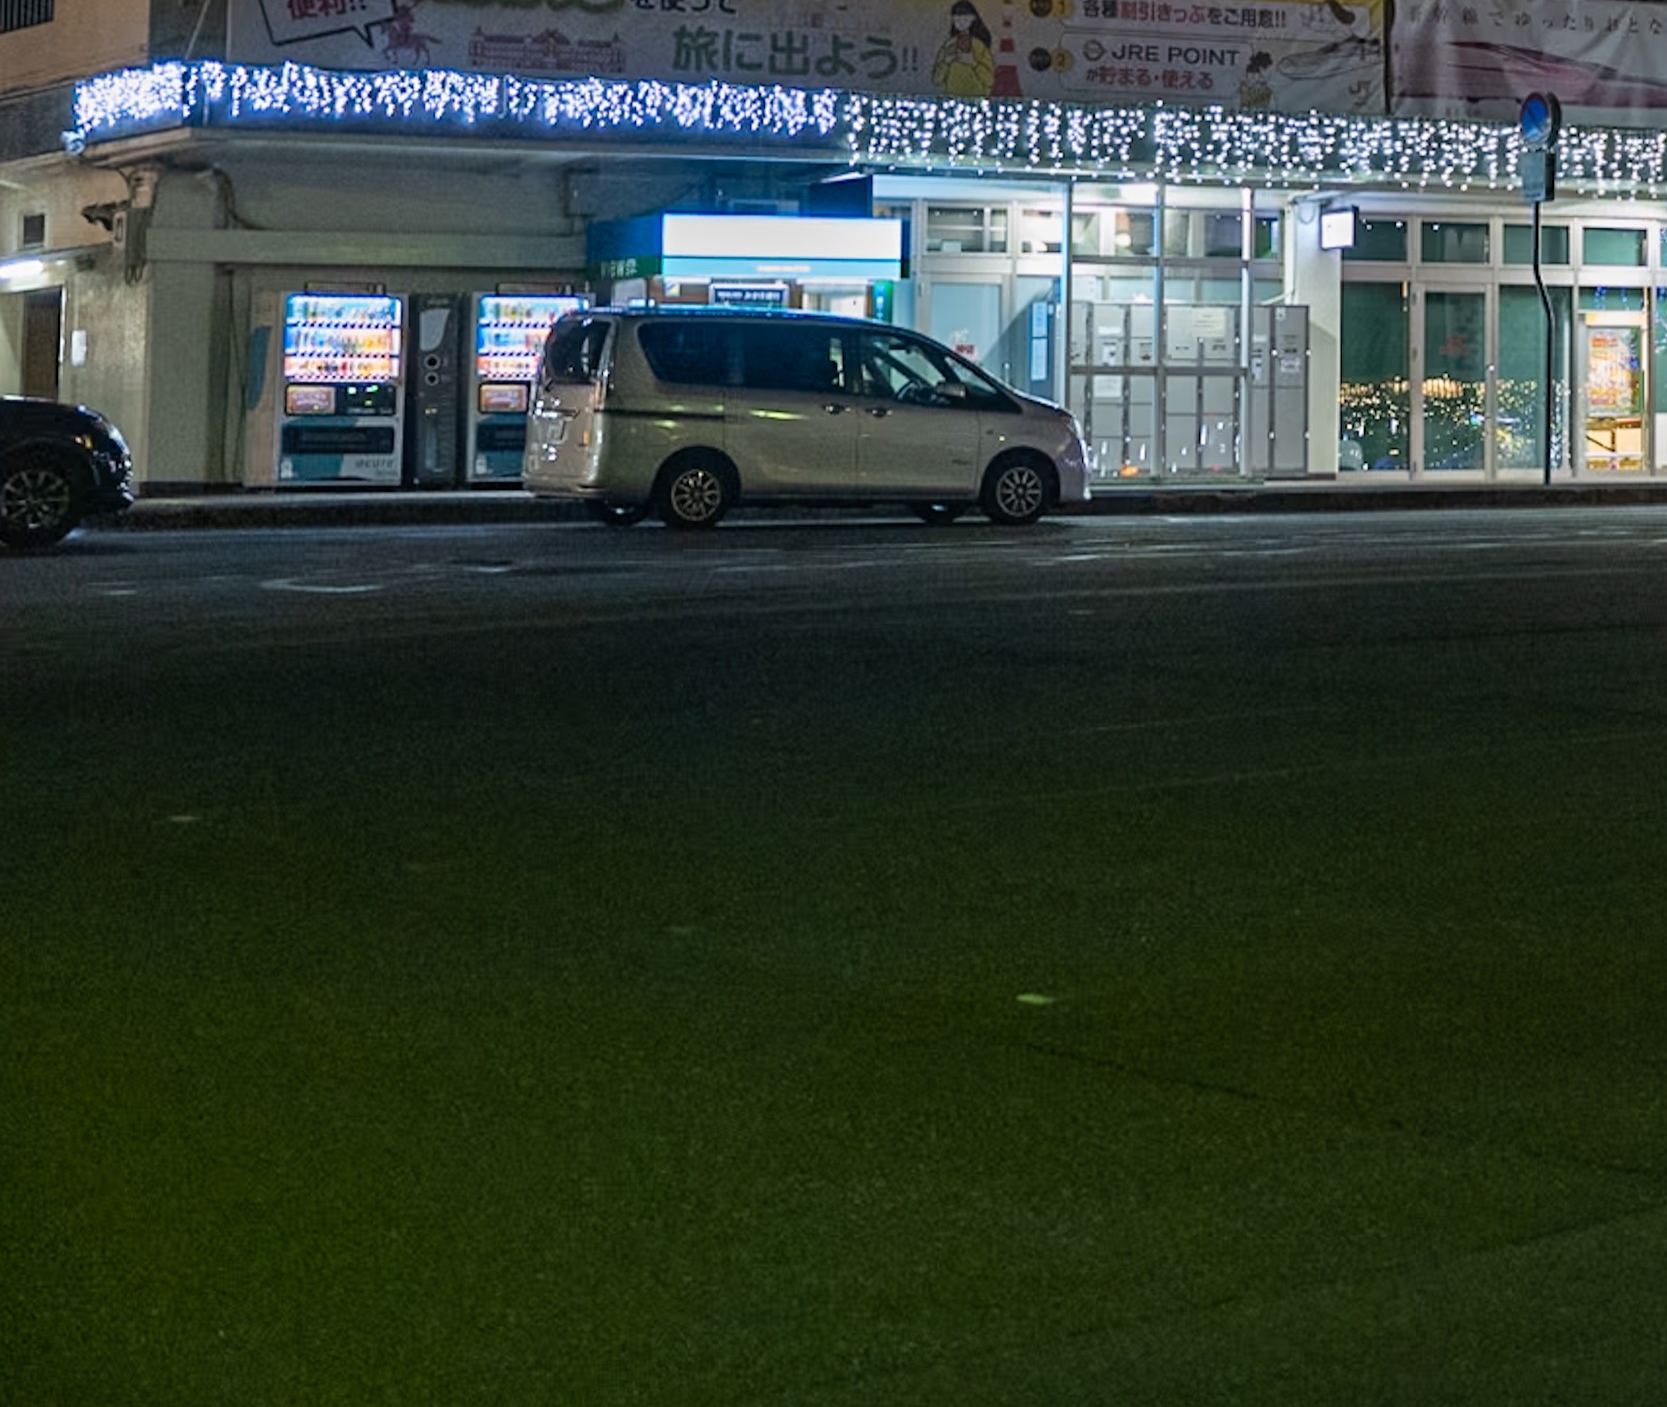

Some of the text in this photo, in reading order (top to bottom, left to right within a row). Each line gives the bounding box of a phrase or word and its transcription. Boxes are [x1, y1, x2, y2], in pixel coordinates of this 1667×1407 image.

[671, 24, 919, 80] 旅に出よう!!
[1111, 43, 1241, 67] JRE POINT
